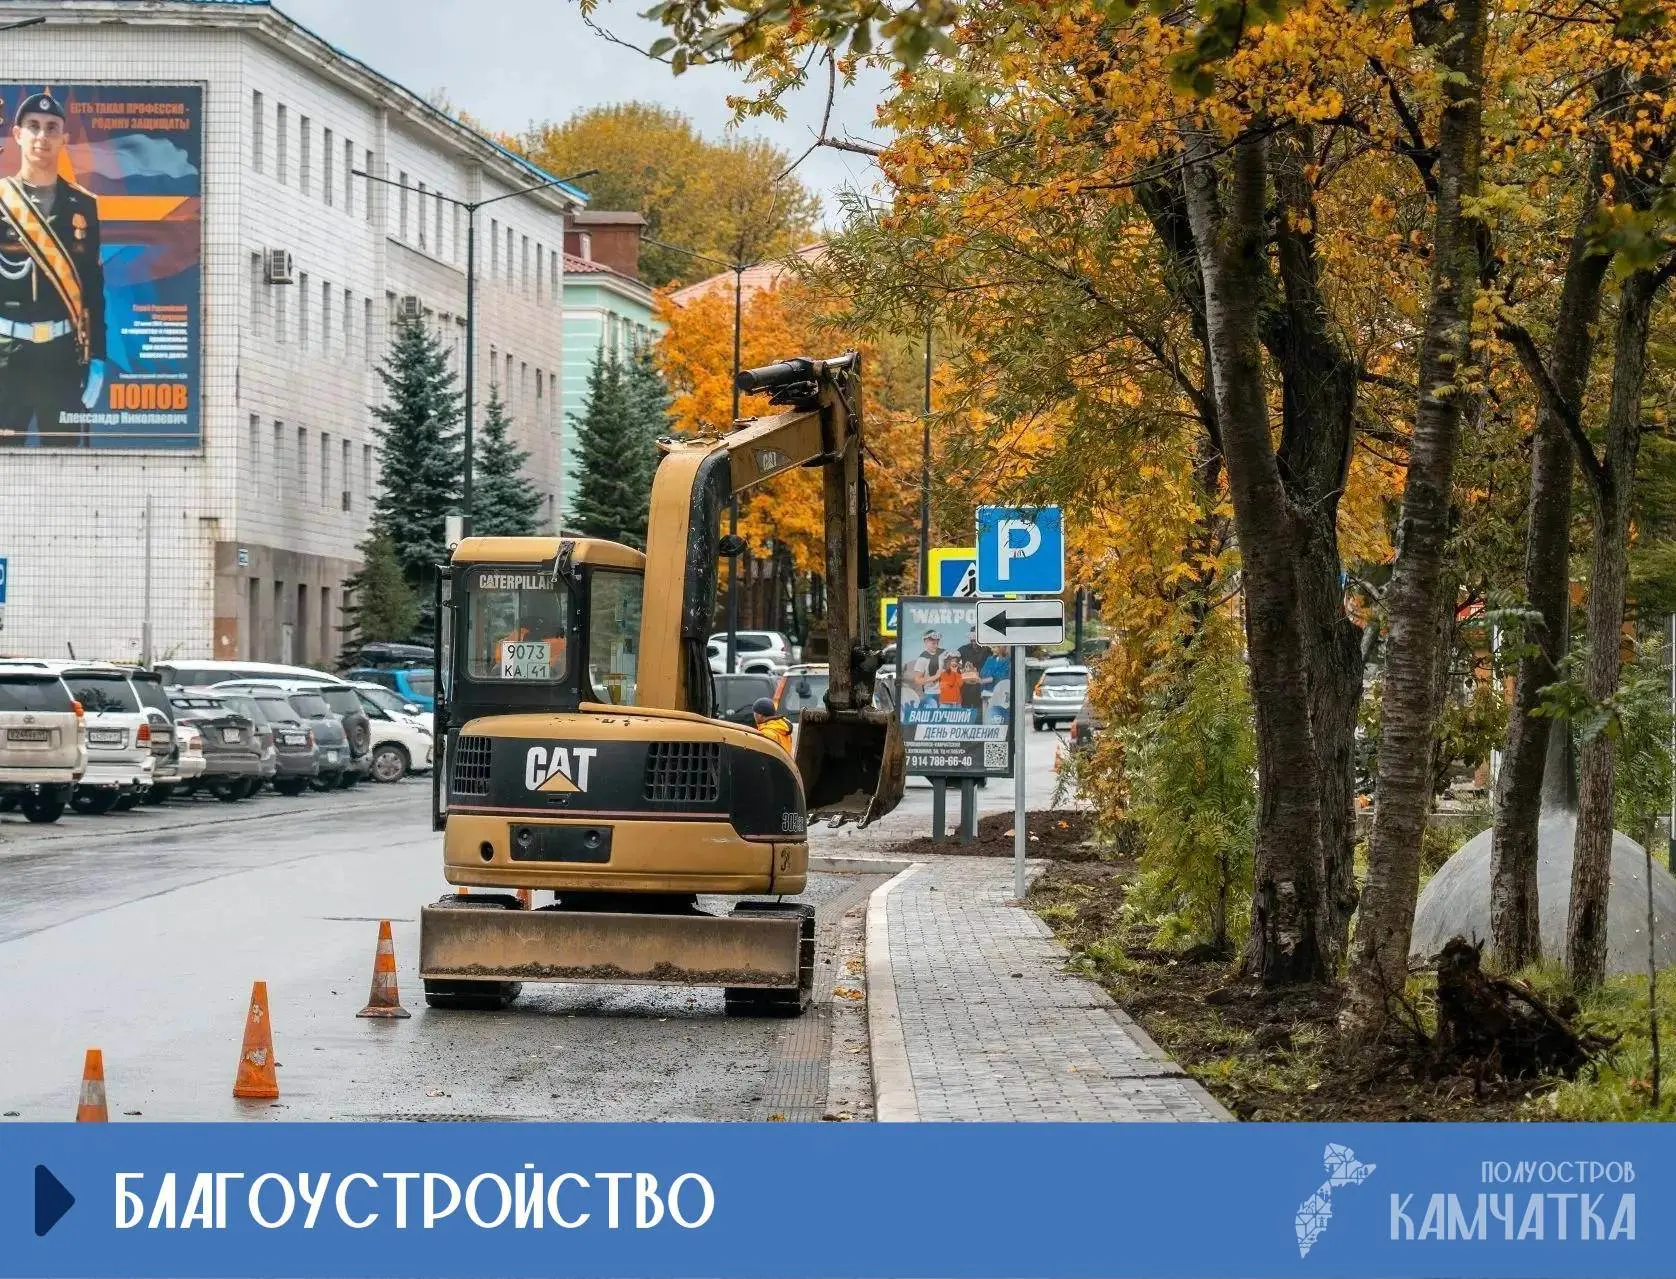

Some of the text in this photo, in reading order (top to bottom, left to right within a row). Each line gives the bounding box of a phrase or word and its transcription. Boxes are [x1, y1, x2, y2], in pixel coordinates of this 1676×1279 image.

[70, 103, 93, 114] ЕСТЬ
[95, 103, 125, 114] ТАКАЯ
[126, 103, 184, 114] ПРОФЕССИЯ
[91, 118, 130, 130] РОДИНУ
[109, 383, 188, 410] ПОПОВ
[59, 411, 188, 425] Александр Николаевич
[997, 519, 1042, 581] P
[480, 574, 554, 590] CATERPILLAR
[910, 608, 976, 624] WARPO
[508, 645, 544, 660] 9073
[532, 666, 546, 677] 41
[909, 708, 971, 722] ВАШ ЛУЧШИЙ
[924, 727, 1000, 739] ДЕНЬ РОЖДЕНИЯ
[912, 756, 928, 766] 914
[525, 746, 597, 792] CAT
